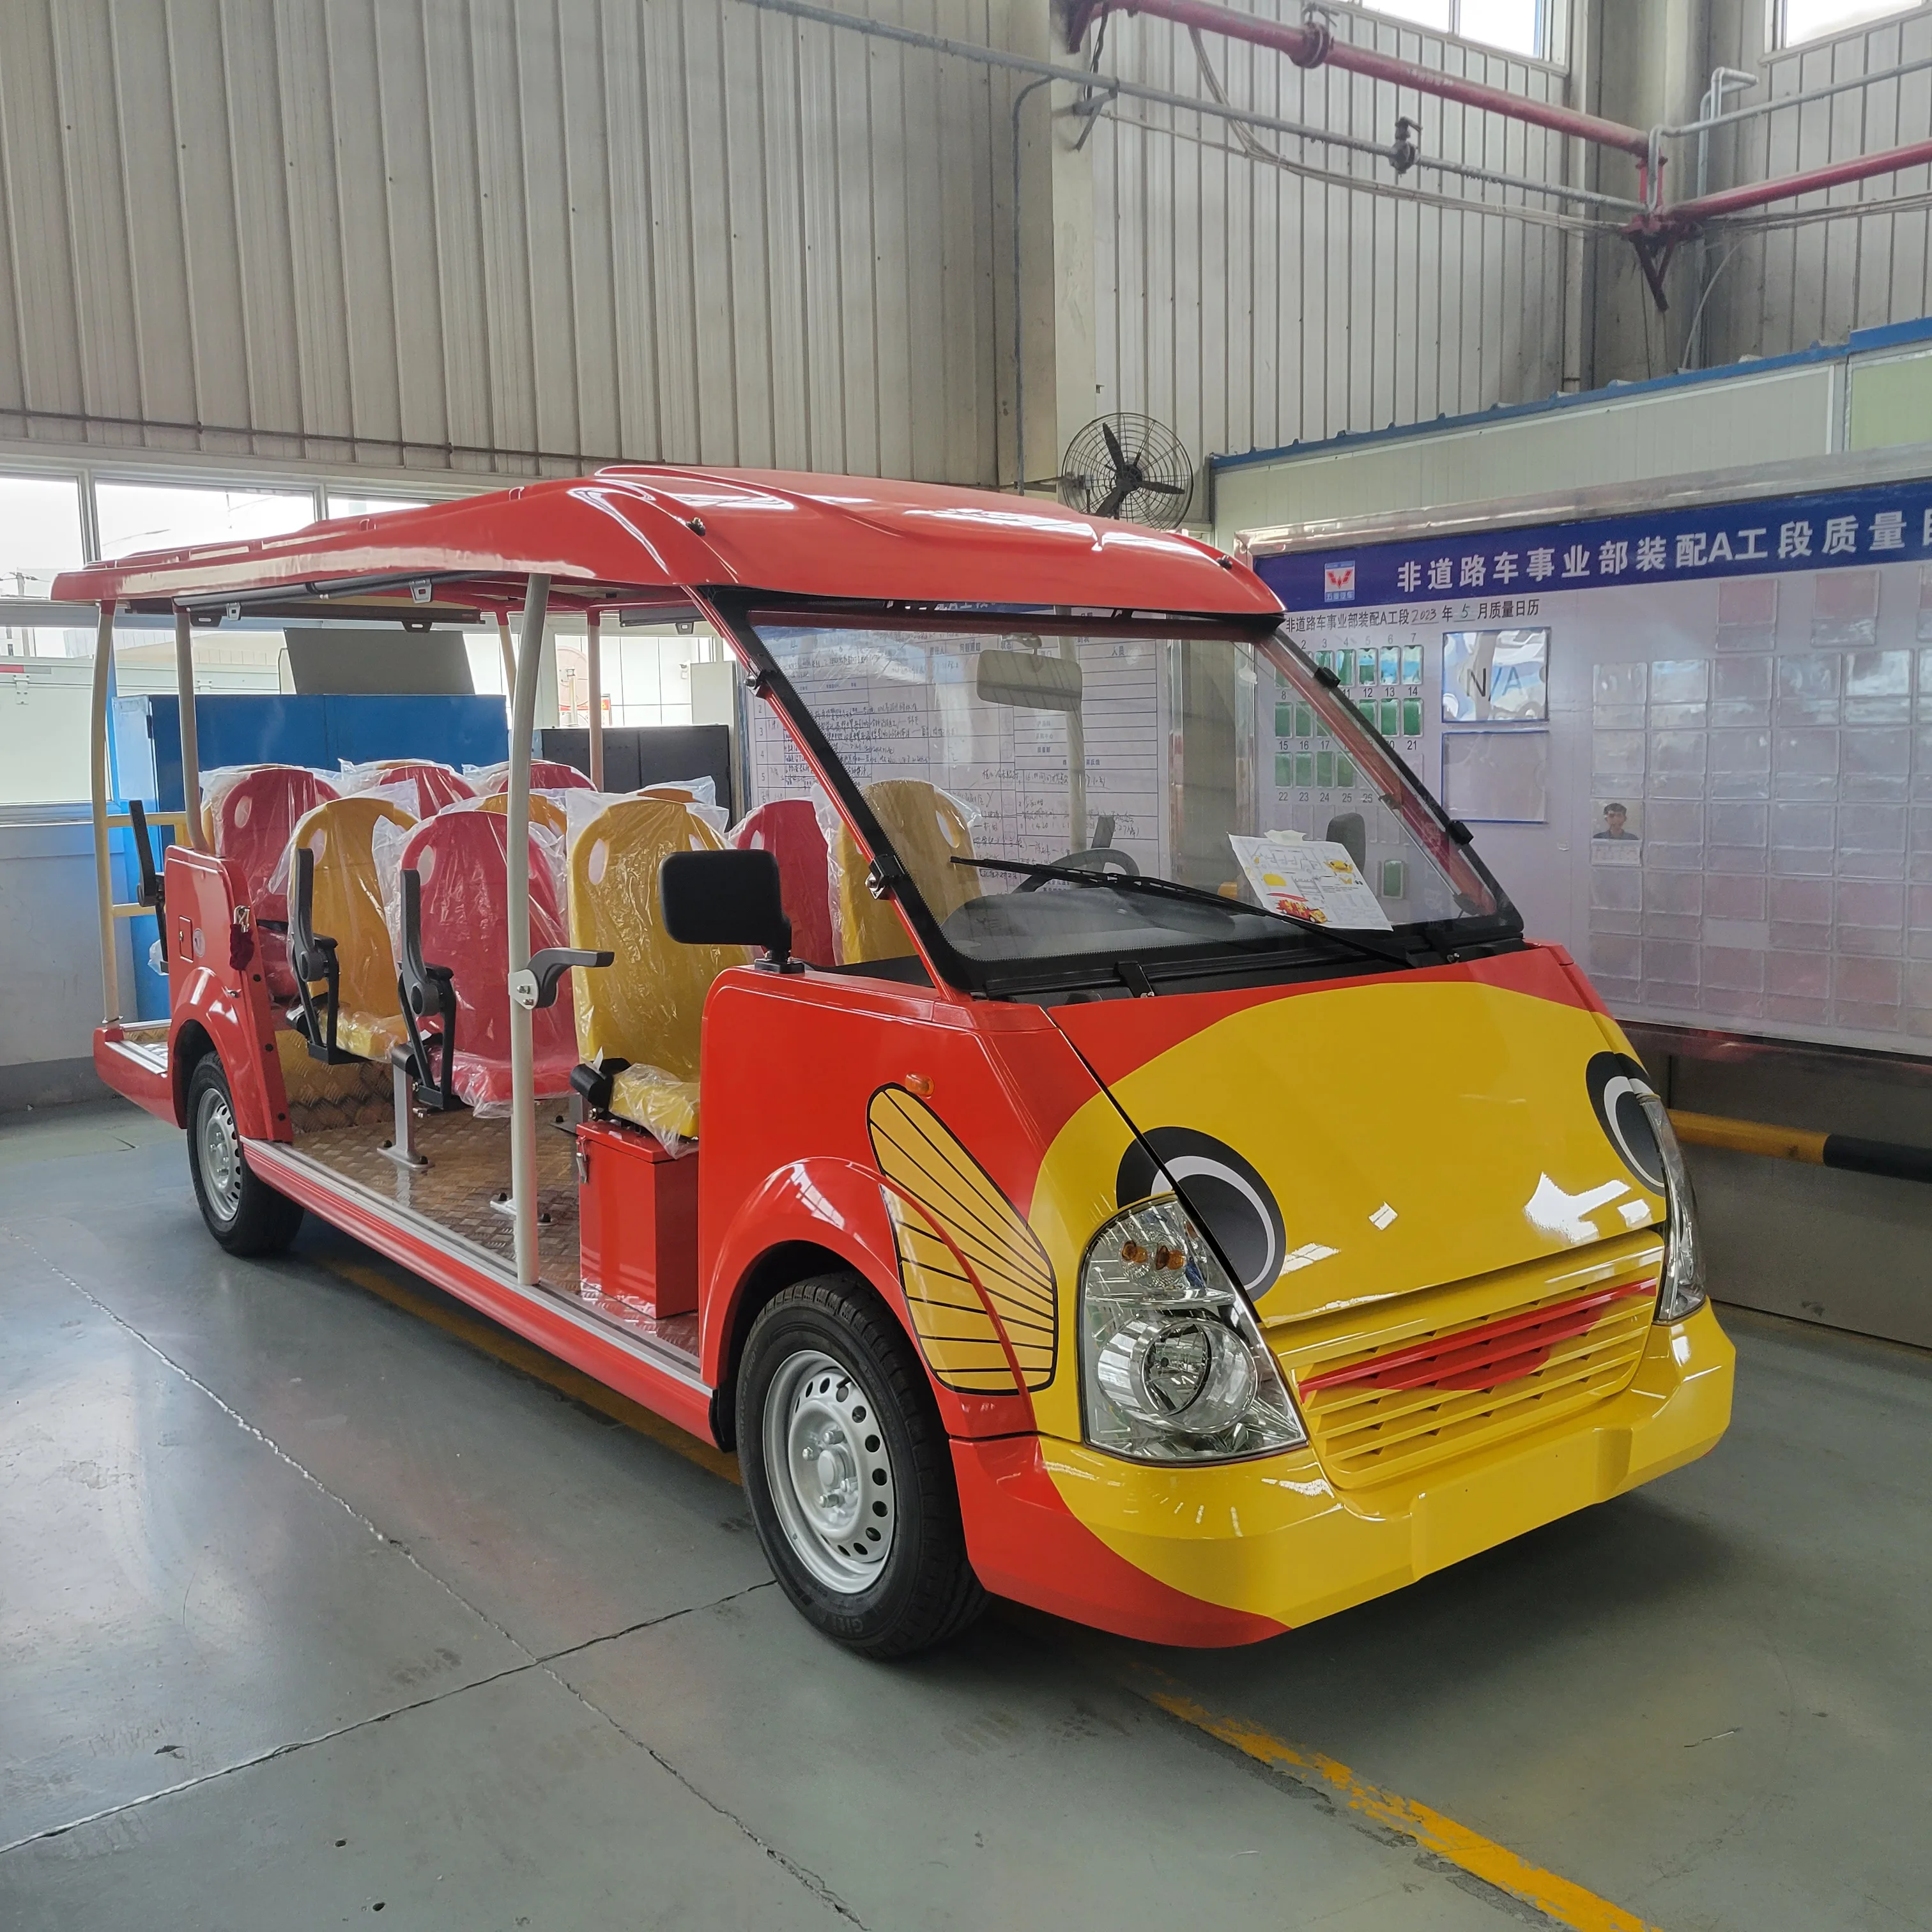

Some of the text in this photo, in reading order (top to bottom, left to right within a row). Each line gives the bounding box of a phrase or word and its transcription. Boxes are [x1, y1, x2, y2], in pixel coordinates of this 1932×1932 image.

[1441, 604, 1453, 623] 年
[1476, 598, 1540, 620] 月质量日历
[1301, 639, 1307, 649] 2
[1322, 638, 1328, 648] 3
[1343, 637, 1349, 647] 4
[1388, 634, 1394, 644] 6
[1410, 633, 1416, 643] 7
[1111, 645, 1124, 656] 人员
[1466, 664, 1524, 703] N/A
[1281, 690, 1287, 700] 8
[1363, 687, 1373, 698] 12
[1385, 687, 1395, 697] 13
[1408, 686, 1418, 696] 14
[758, 705, 762, 714] 2
[760, 727, 763, 736] 3
[1279, 740, 1289, 751] 15
[1300, 740, 1309, 750] 16
[1321, 740, 1330, 750] 17
[1407, 740, 1417, 751] 21
[761, 772, 765, 781] 5
[1278, 792, 1288, 802] 22
[1298, 792, 1309, 802] 23
[1319, 792, 1330, 802] 24
[1342, 793, 1353, 803] 25
